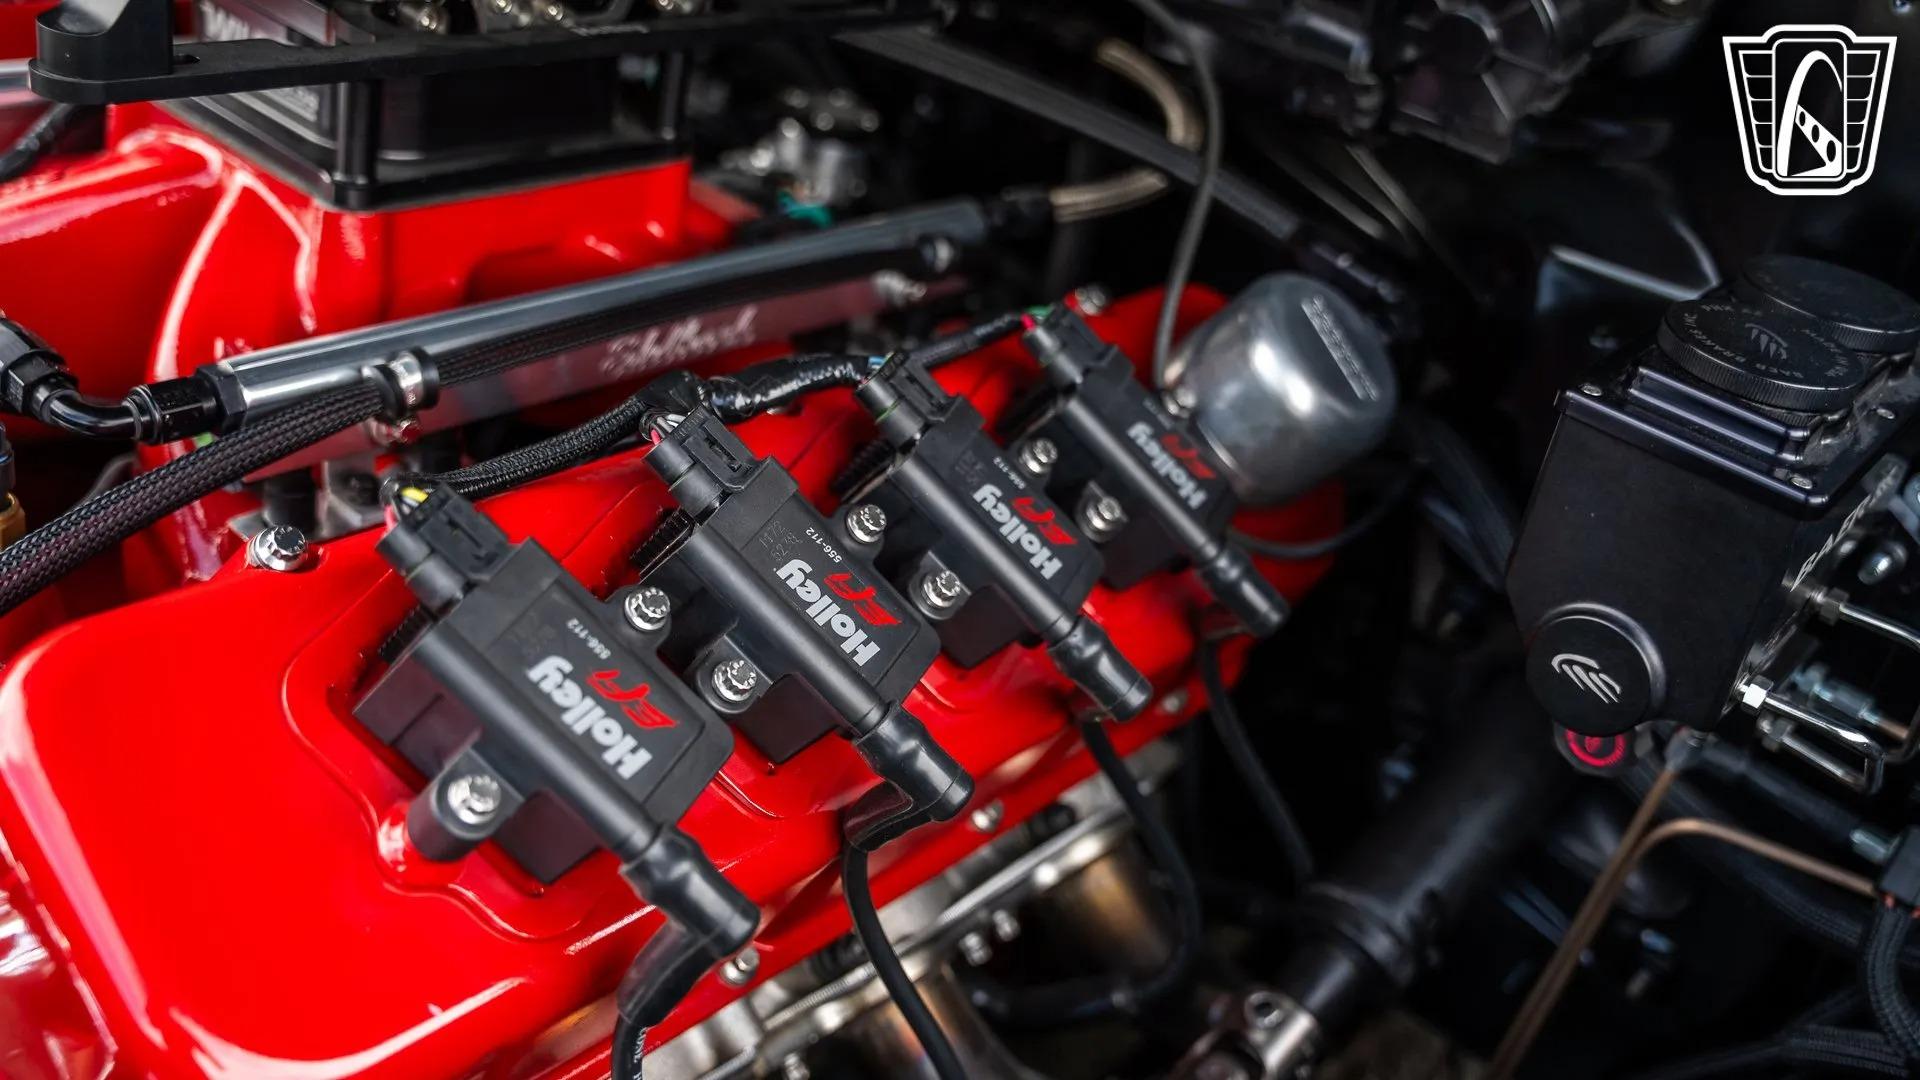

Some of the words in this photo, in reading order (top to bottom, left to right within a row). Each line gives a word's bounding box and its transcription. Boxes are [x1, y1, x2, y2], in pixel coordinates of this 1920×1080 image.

[1126, 421, 1207, 509] Holley
[805, 526, 842, 563] 556-112
[973, 484, 1062, 580] Holley
[776, 559, 881, 667] Holley
[824, 572, 902, 626] EFI
[526, 655, 653, 780] Holley
[586, 668, 677, 730] EFI
